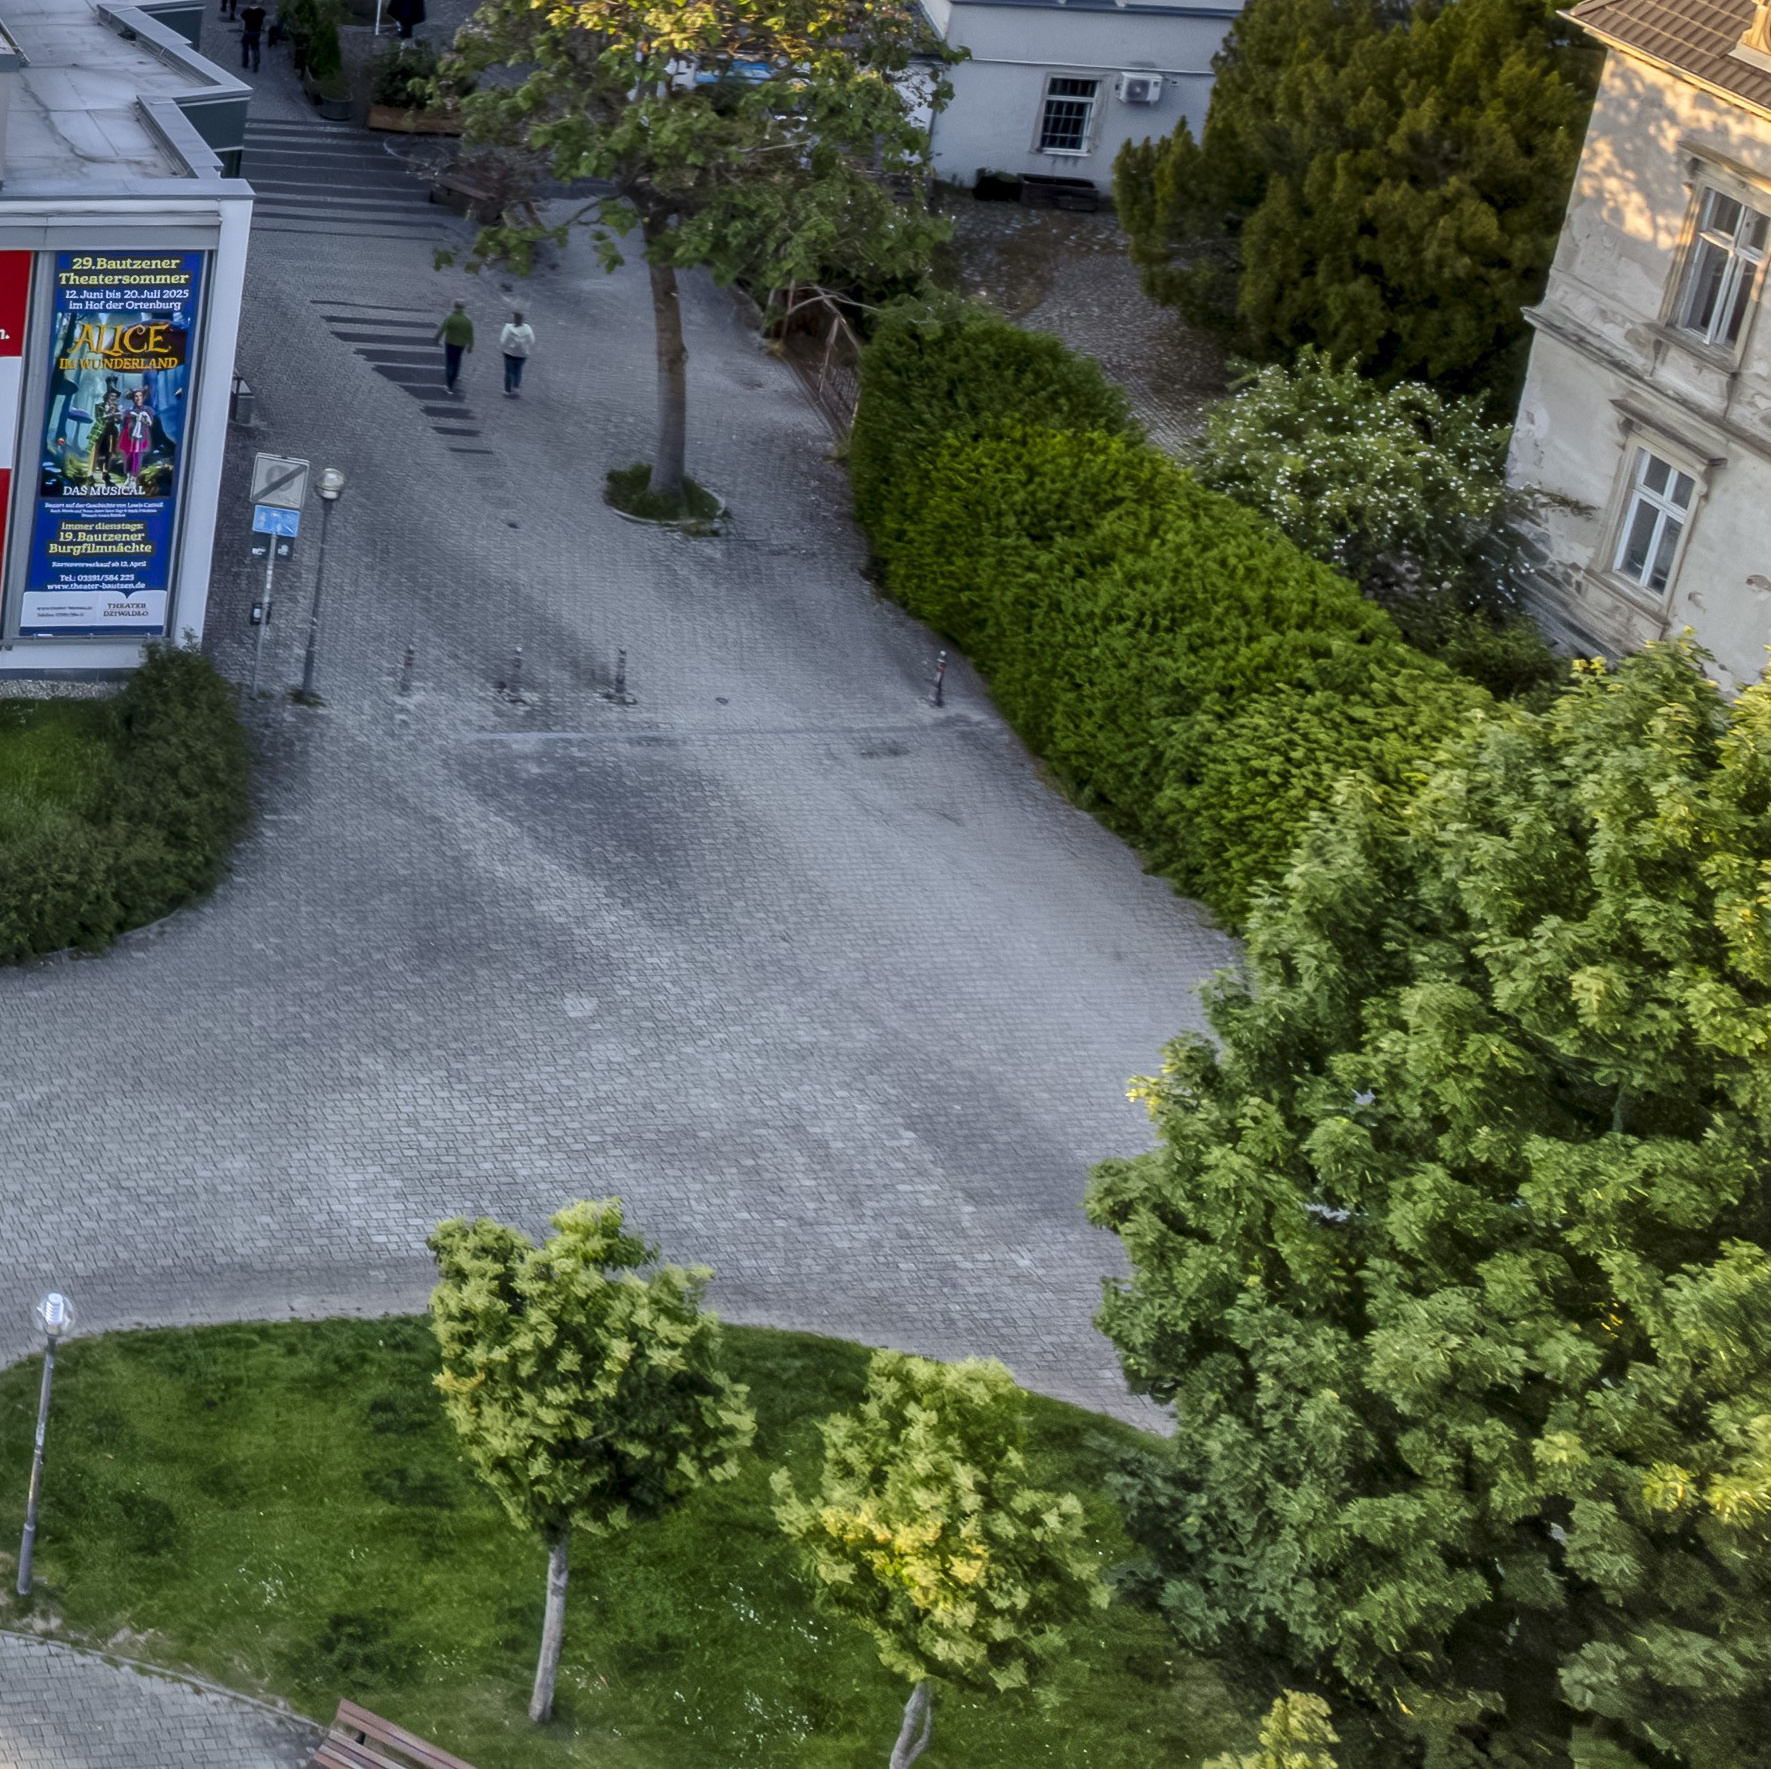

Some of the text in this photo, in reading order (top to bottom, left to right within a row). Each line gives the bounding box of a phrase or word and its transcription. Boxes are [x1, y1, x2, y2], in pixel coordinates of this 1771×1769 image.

[59, 272, 189, 285] Theatersommer
[105, 290, 121, 299] bis
[162, 290, 190, 299] 2025
[69, 301, 182, 311] im Hof der Ortenburg
[67, 323, 172, 357] ALICE
[80, 357, 178, 370] WUNDERLAND
[63, 485, 146, 496] DAS MUSICAL
